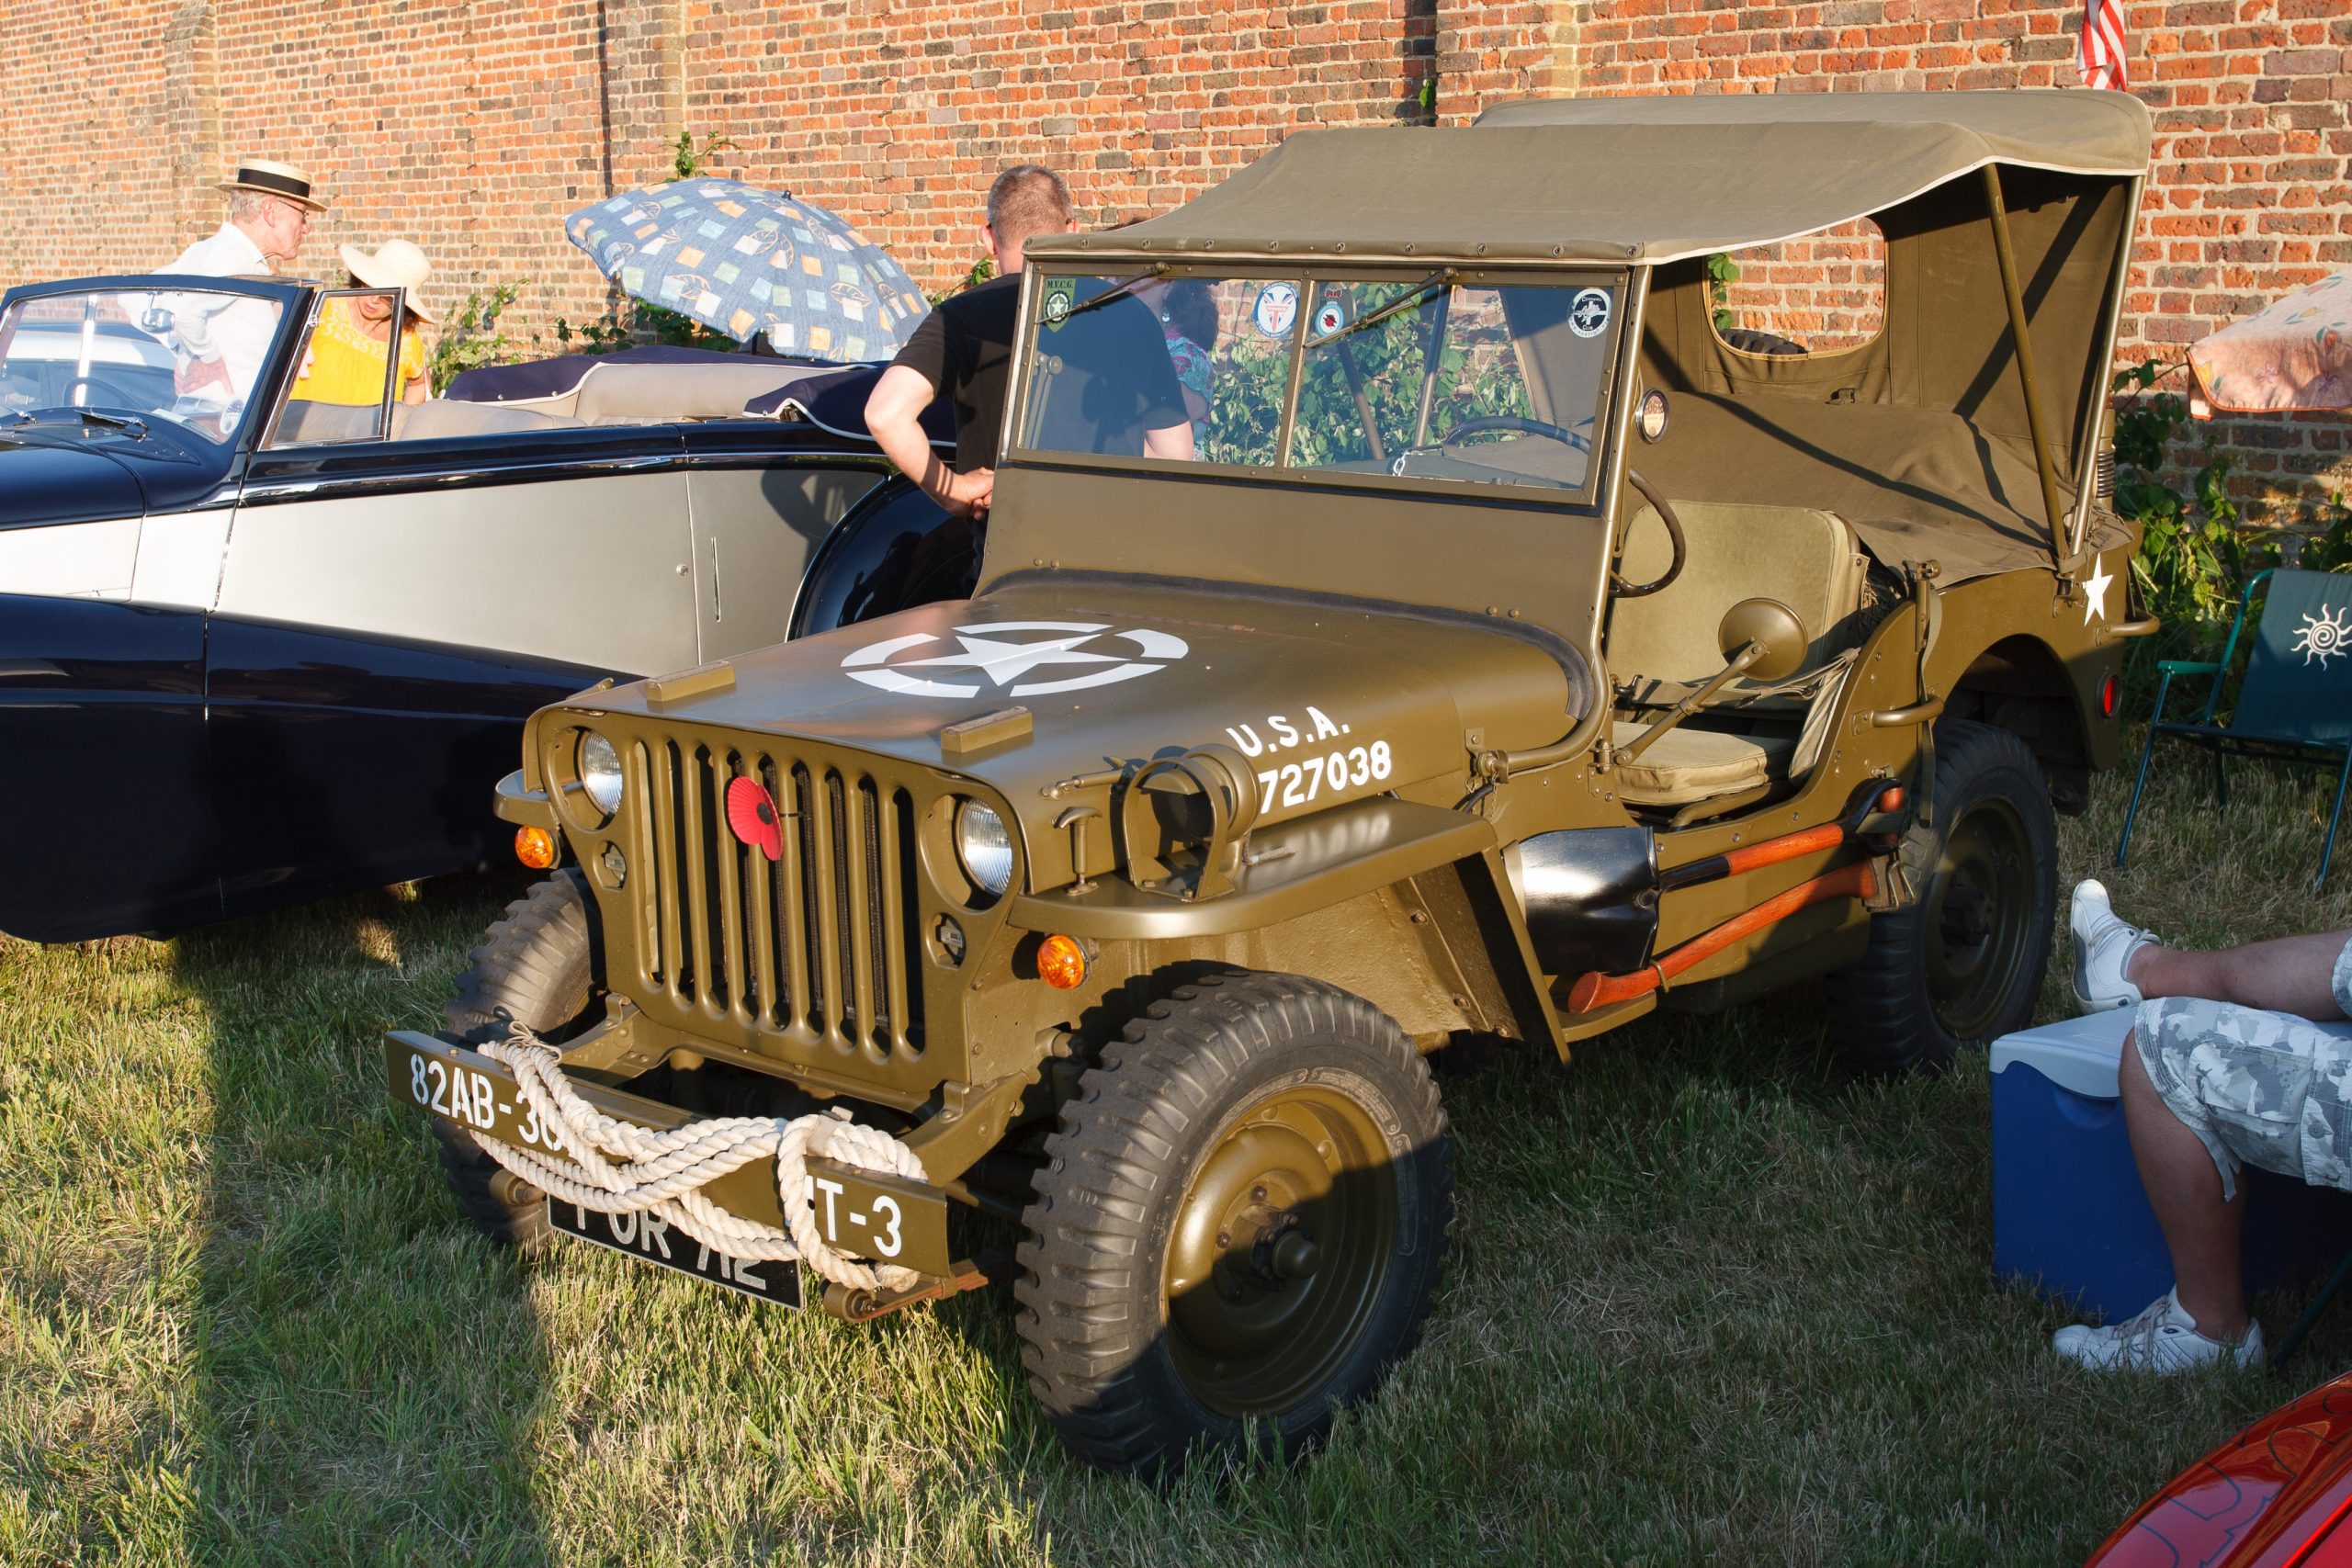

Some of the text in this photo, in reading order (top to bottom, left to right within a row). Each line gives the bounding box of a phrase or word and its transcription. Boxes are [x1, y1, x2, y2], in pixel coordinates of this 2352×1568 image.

[1046, 279, 1074, 288] M.V.C.G.
[1226, 706, 1351, 757] U.S.A.
[1258, 740, 1392, 815] 727038
[786, 1175, 902, 1258] T-3
